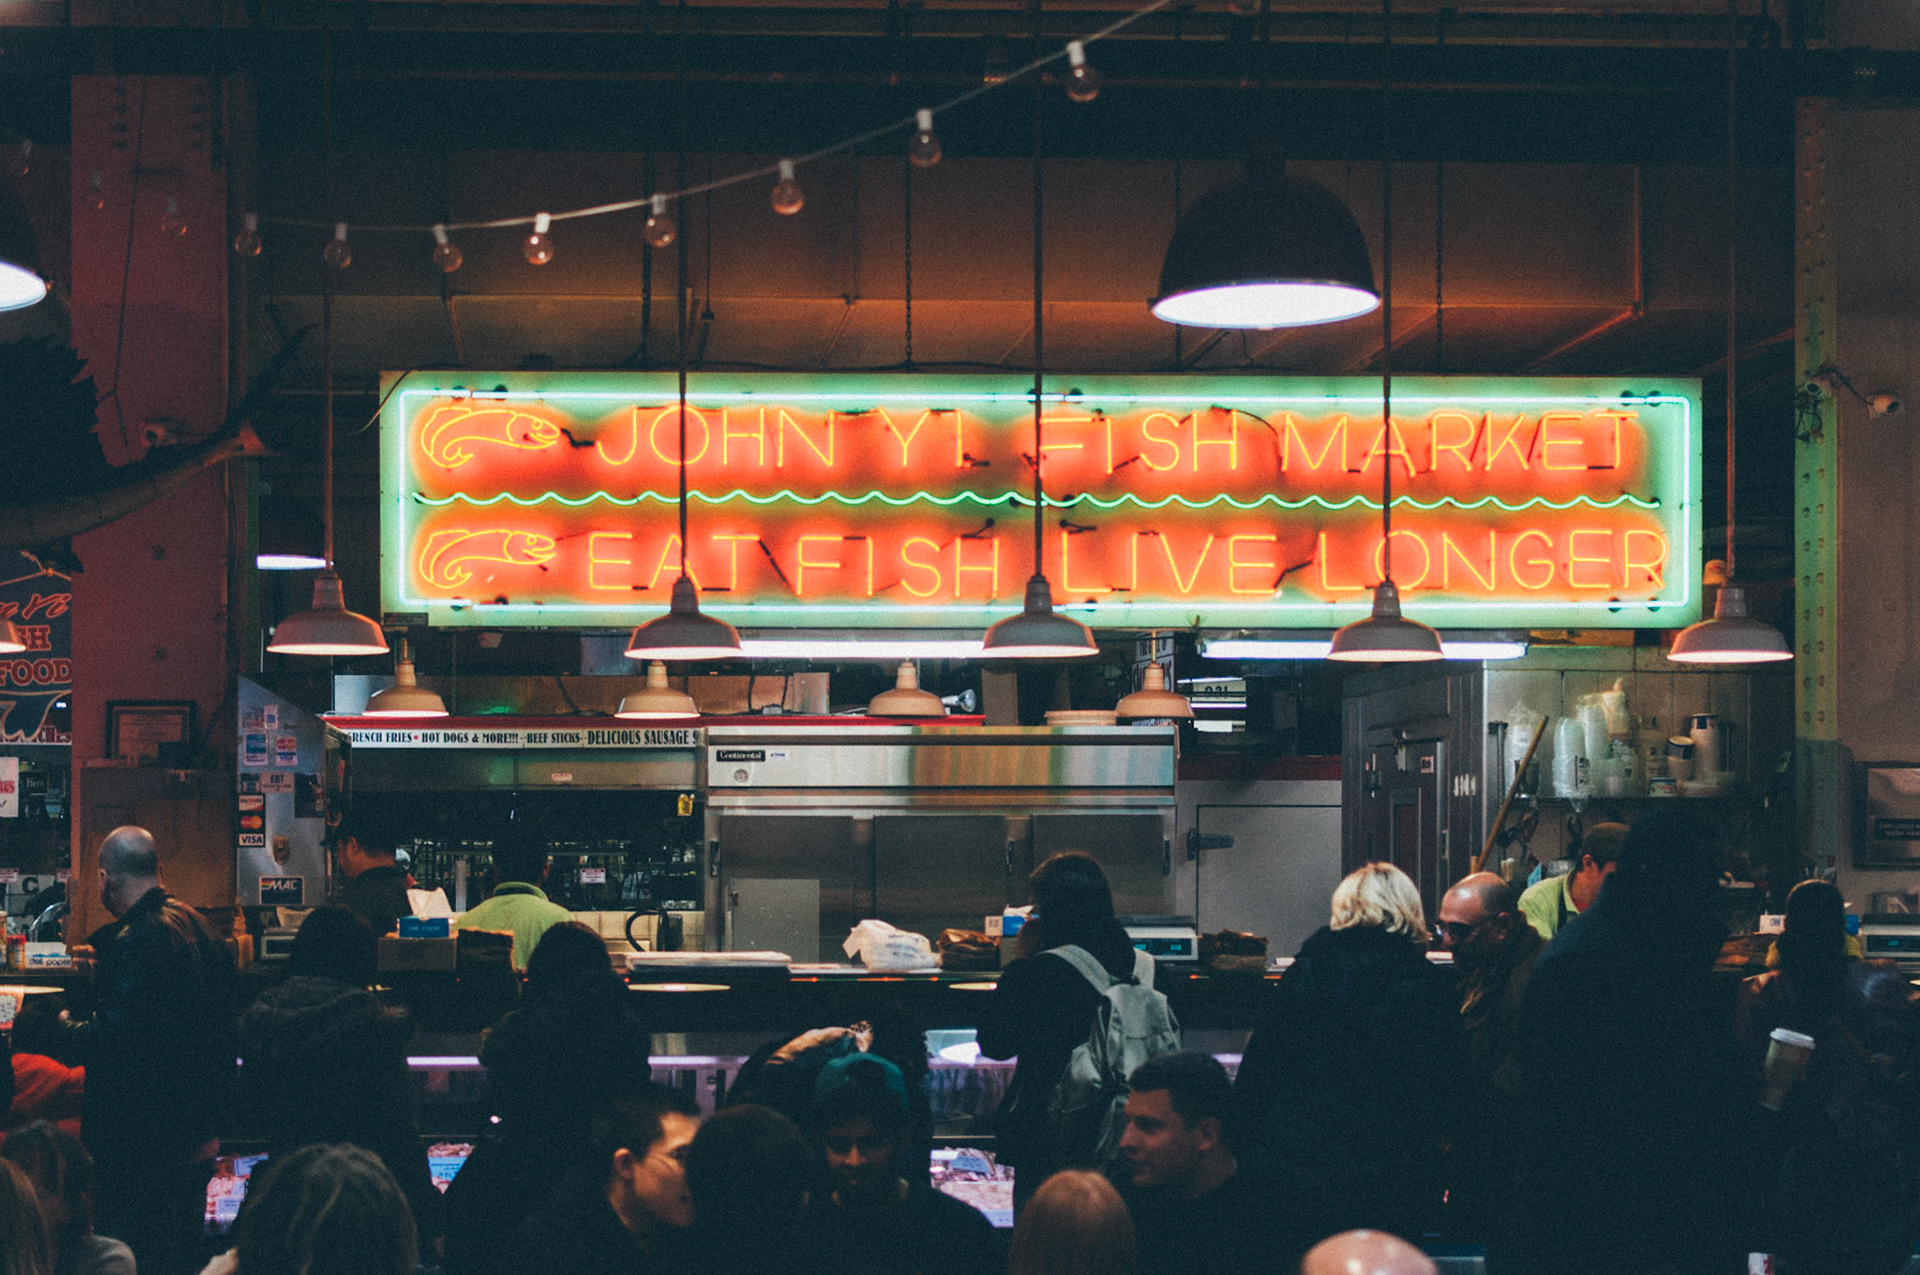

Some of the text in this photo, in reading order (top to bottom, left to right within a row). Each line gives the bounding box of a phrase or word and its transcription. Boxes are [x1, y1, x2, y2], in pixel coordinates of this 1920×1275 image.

[594, 404, 1640, 476] JOHN YI FISH MARKET
[587, 529, 1669, 598] EAT FISH LIVE LONGER
[348, 731, 382, 744] RENCH
[386, 731, 412, 744] FRIES
[421, 732, 440, 744] HOT
[443, 732, 469, 744] DOGS
[471, 733, 479, 744] &
[482, 732, 519, 744] MORE!!!
[527, 732, 548, 744] BEEF
[551, 732, 580, 744] STICKS
[587, 729, 641, 745] DELICIOUS
[644, 729, 690, 745] SAUSAGE
[720, 750, 762, 760] Continental
[242, 836, 262, 844] VISA
[267, 880, 298, 891] MAC
